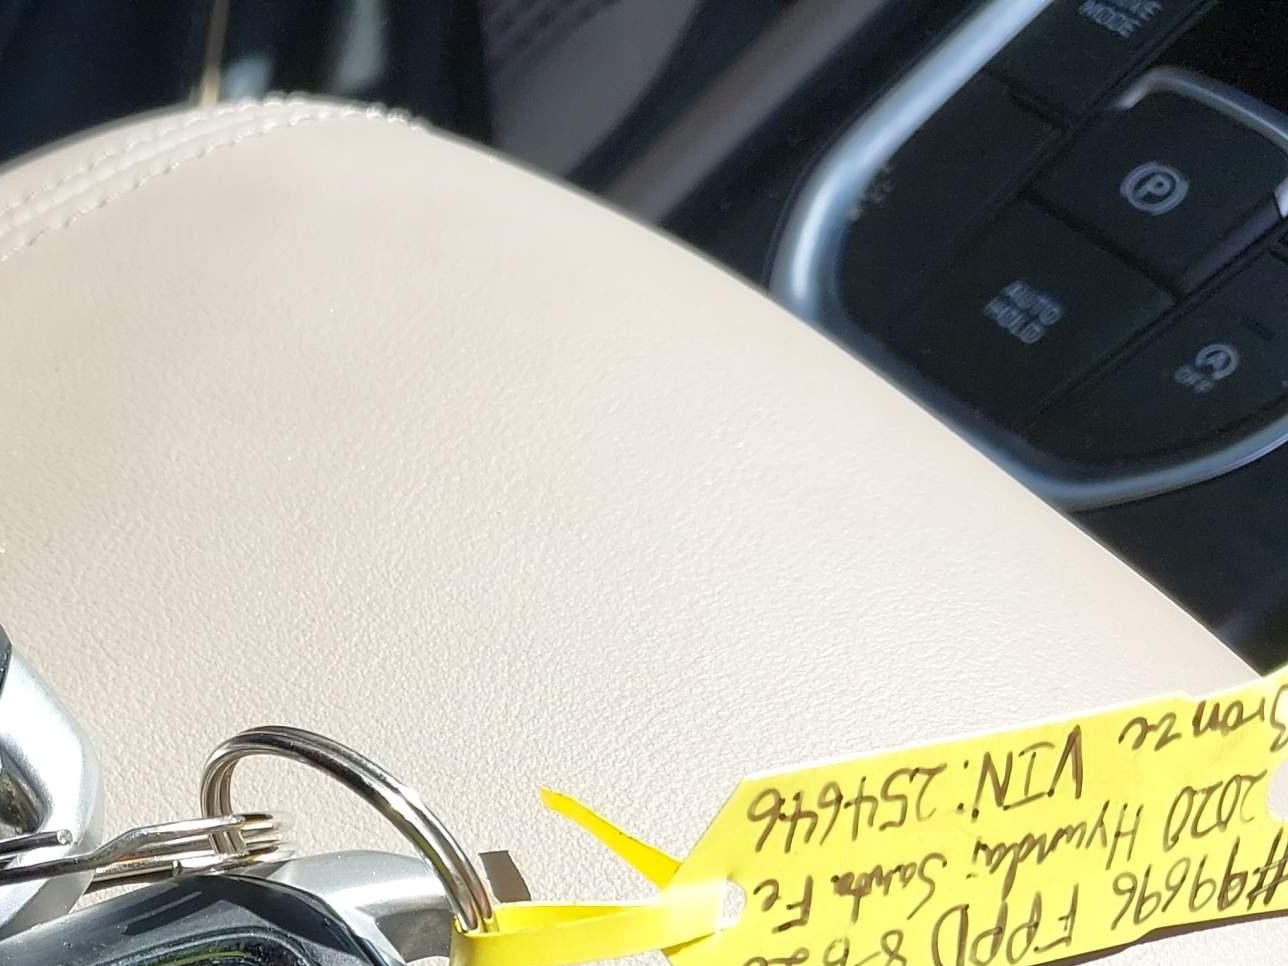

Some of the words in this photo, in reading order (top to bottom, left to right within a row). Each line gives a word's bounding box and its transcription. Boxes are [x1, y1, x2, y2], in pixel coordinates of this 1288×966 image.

[981, 296, 1042, 344] HOLD
[999, 279, 1059, 327] AUTO
[746, 762, 948, 853] 254646
[955, 724, 1084, 822] VIN:
[1163, 769, 1268, 852] 2020
[753, 874, 813, 933] Fe
